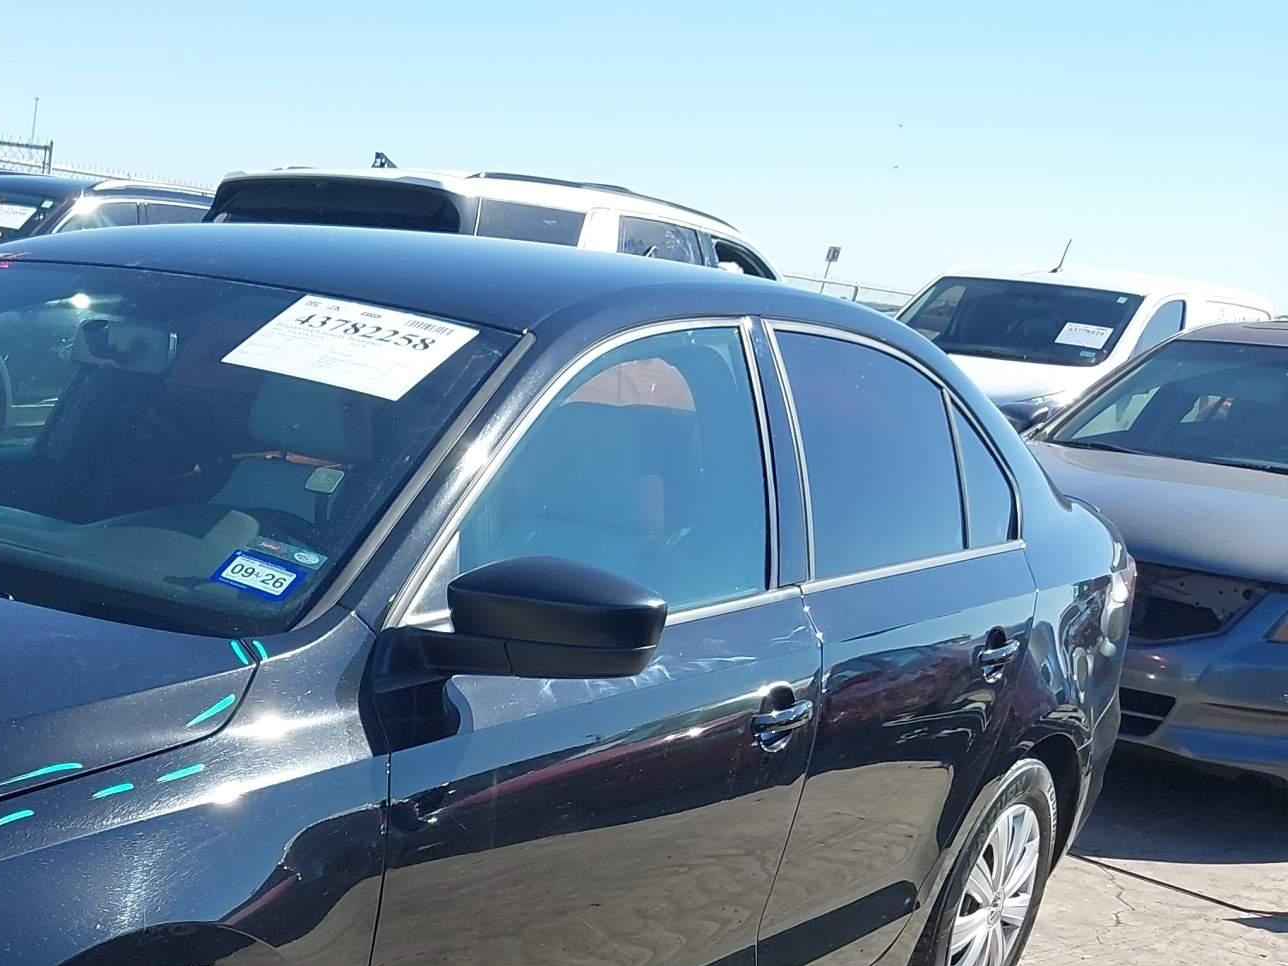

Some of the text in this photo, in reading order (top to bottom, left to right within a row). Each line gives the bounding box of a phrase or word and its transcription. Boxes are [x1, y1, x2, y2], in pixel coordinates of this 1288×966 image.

[294, 313, 436, 351] 43782258
[230, 563, 256, 578] 09
[260, 573, 288, 589] 26
